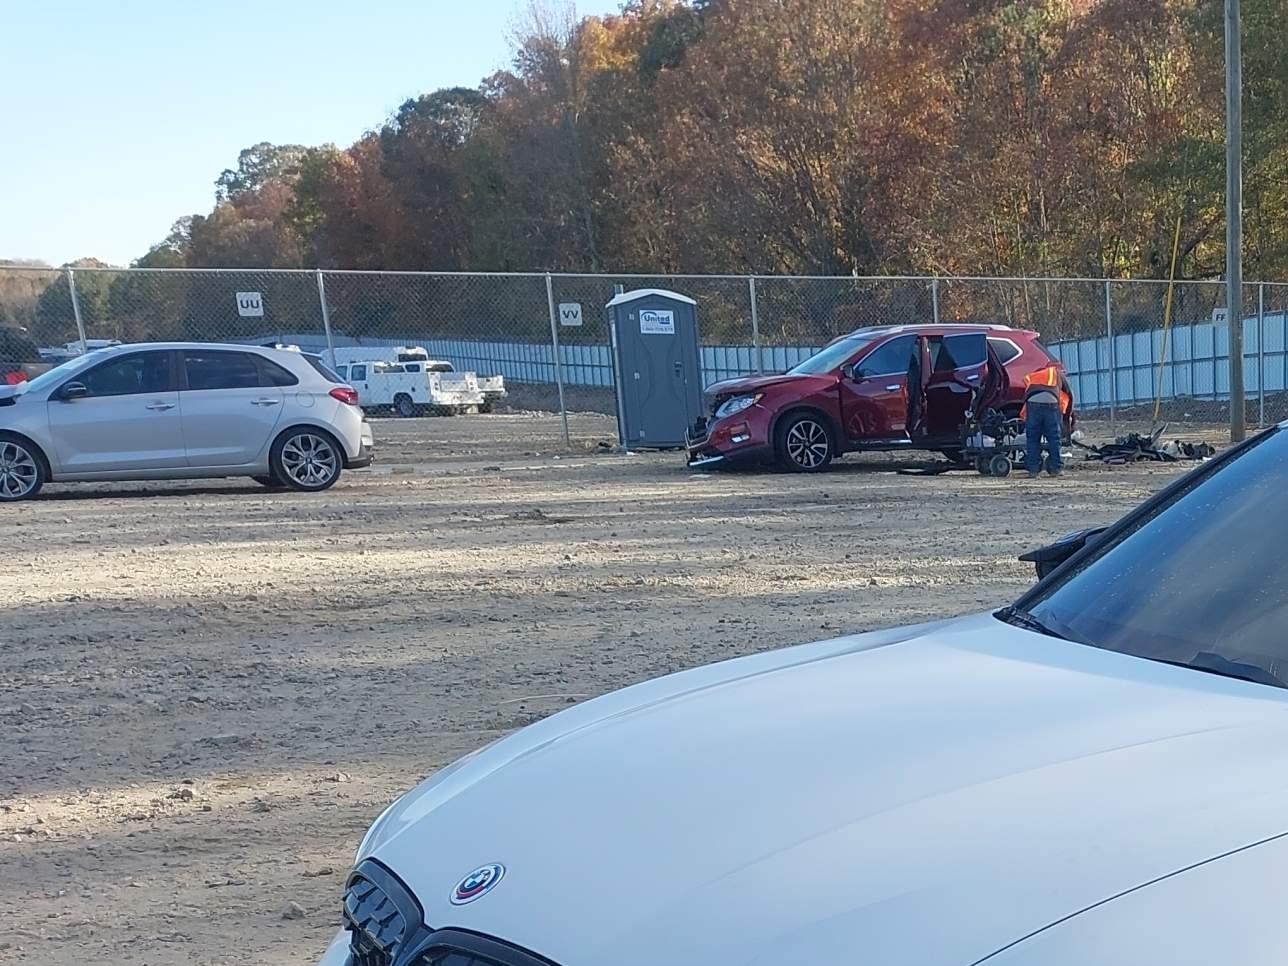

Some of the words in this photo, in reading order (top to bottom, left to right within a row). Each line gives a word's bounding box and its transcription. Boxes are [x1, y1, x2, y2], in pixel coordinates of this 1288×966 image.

[239, 299, 260, 309] UU
[562, 310, 579, 319] VV
[643, 314, 671, 322] United
